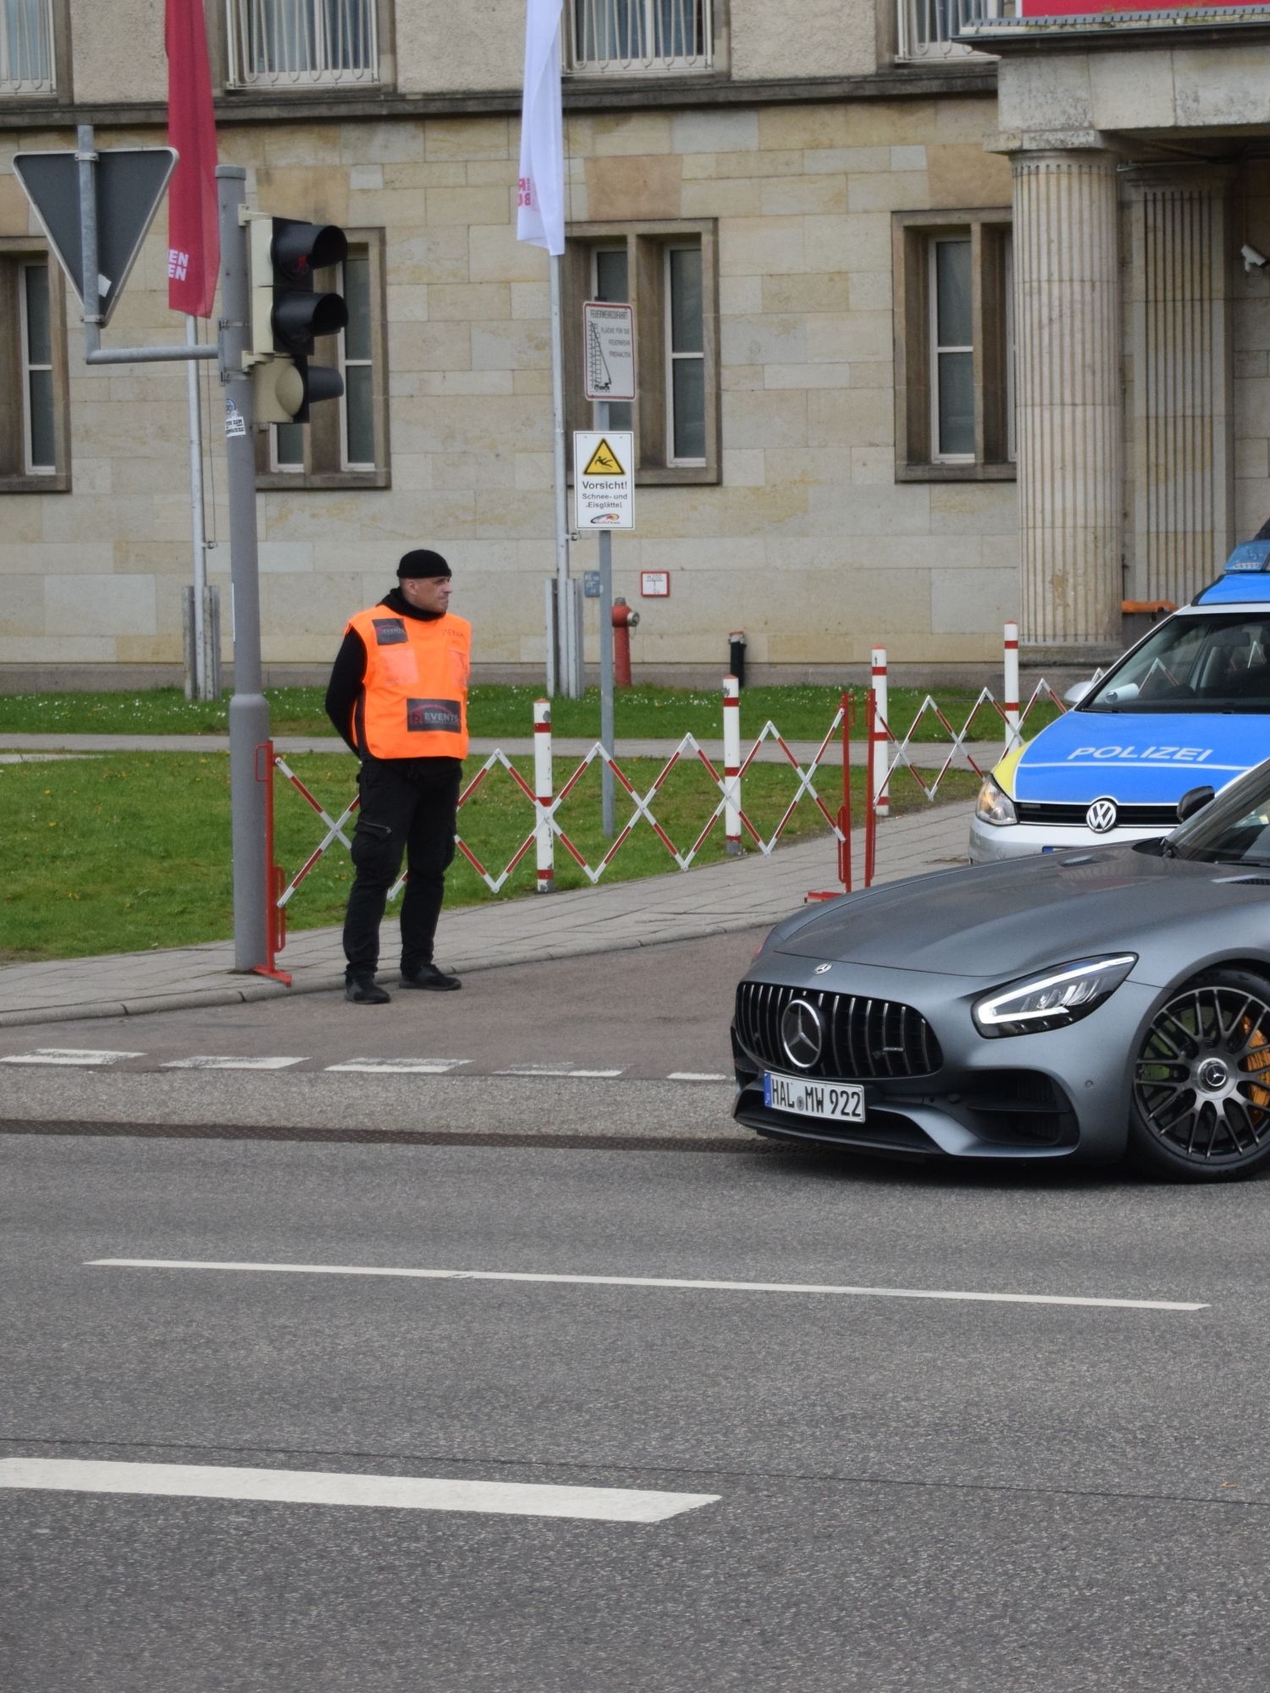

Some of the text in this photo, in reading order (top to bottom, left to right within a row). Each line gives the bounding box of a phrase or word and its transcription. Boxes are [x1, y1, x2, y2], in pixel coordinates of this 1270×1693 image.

[582, 481, 628, 490] Vorsicht!
[1067, 745, 1213, 762] POLIZEI
[771, 1078, 862, 1117] HAL MW 922
